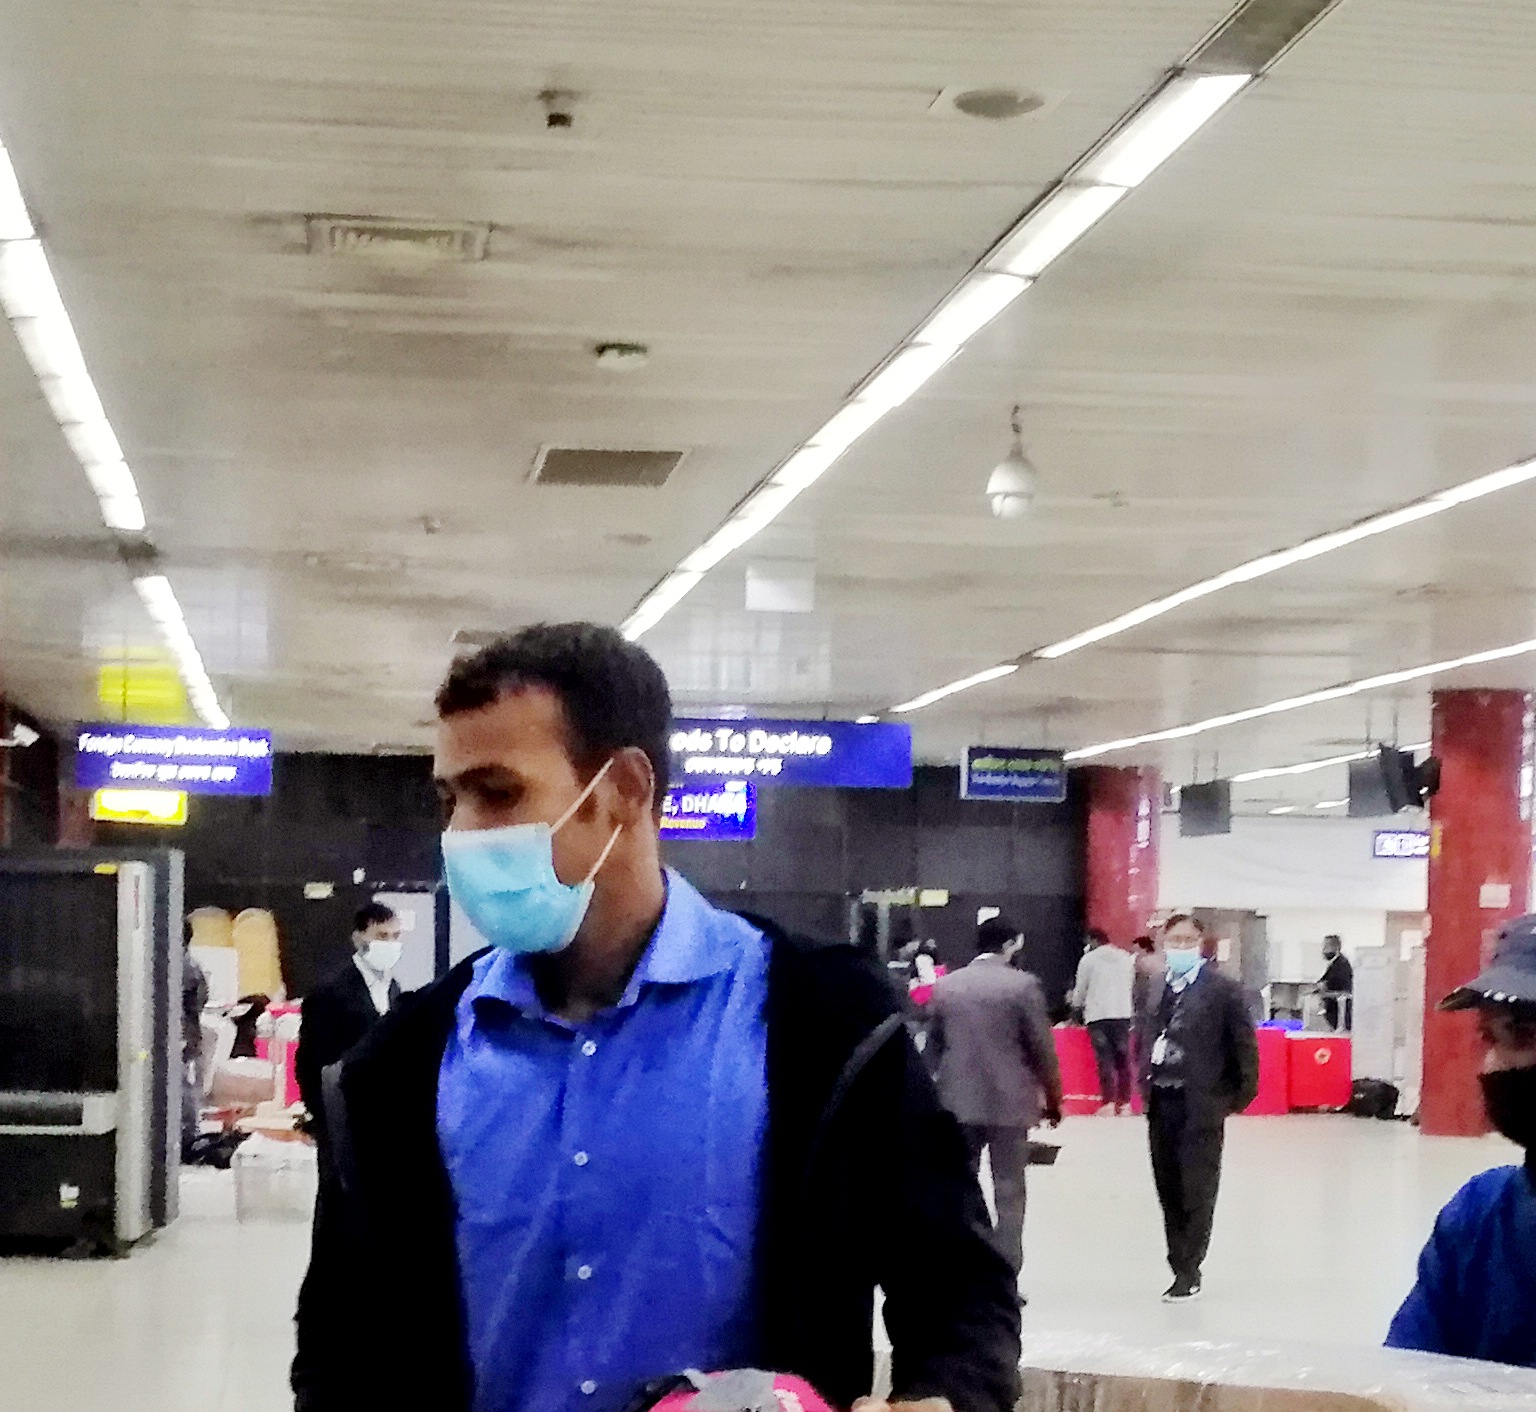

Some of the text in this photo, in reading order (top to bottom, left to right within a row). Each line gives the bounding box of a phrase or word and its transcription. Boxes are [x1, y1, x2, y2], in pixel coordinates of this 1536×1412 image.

[668, 728, 833, 757] ods To Declare
